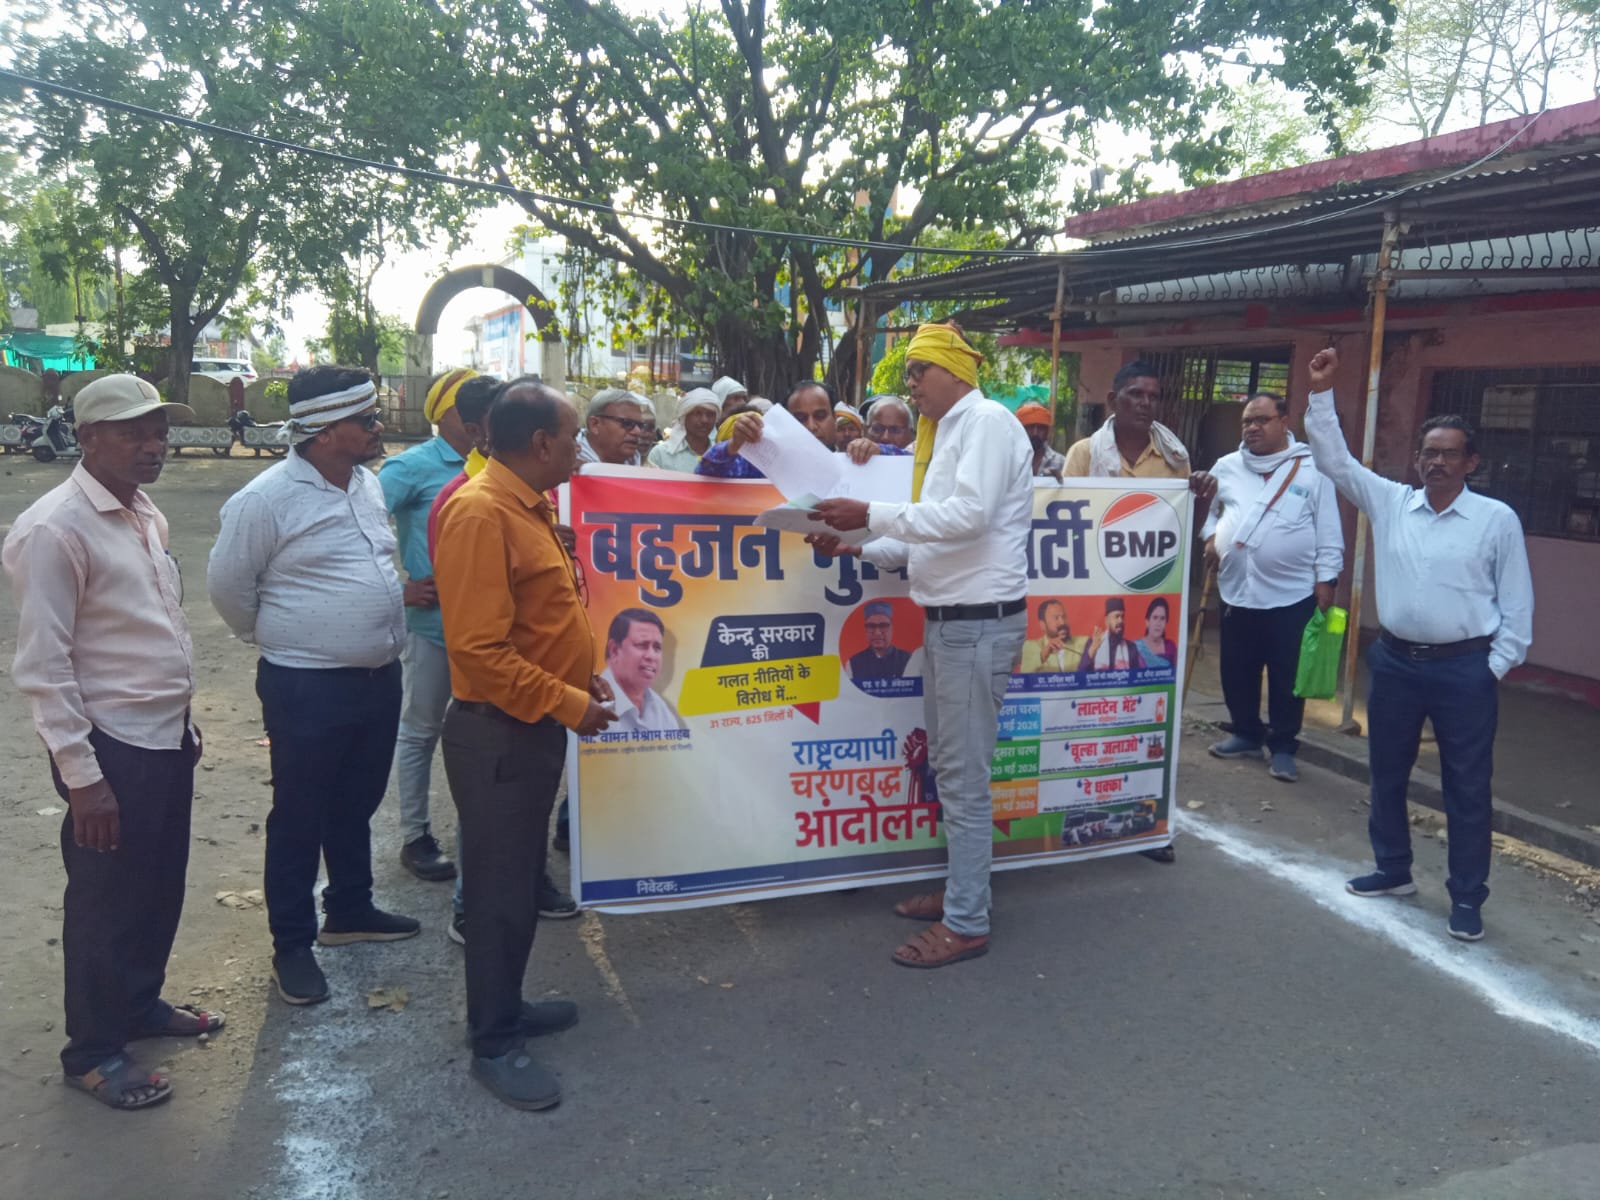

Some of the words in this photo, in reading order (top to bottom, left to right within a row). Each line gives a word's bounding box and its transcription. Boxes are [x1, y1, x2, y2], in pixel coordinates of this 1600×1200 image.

[1103, 530, 1177, 558] BMP
[582, 511, 785, 608] बहुजन
[717, 622, 755, 647] केन्द्र
[759, 623, 816, 645] सरकार
[751, 644, 770, 661] की
[717, 674, 749, 690] गलत
[753, 664, 795, 684] नीतियों
[797, 664, 811, 680] के
[736, 687, 772, 707] विरोध
[599, 730, 629, 744] वामन
[791, 728, 898, 771] राष्ट्रव्यापी
[789, 765, 904, 799] चरणबद्ध
[794, 793, 942, 849] आंदोलन
